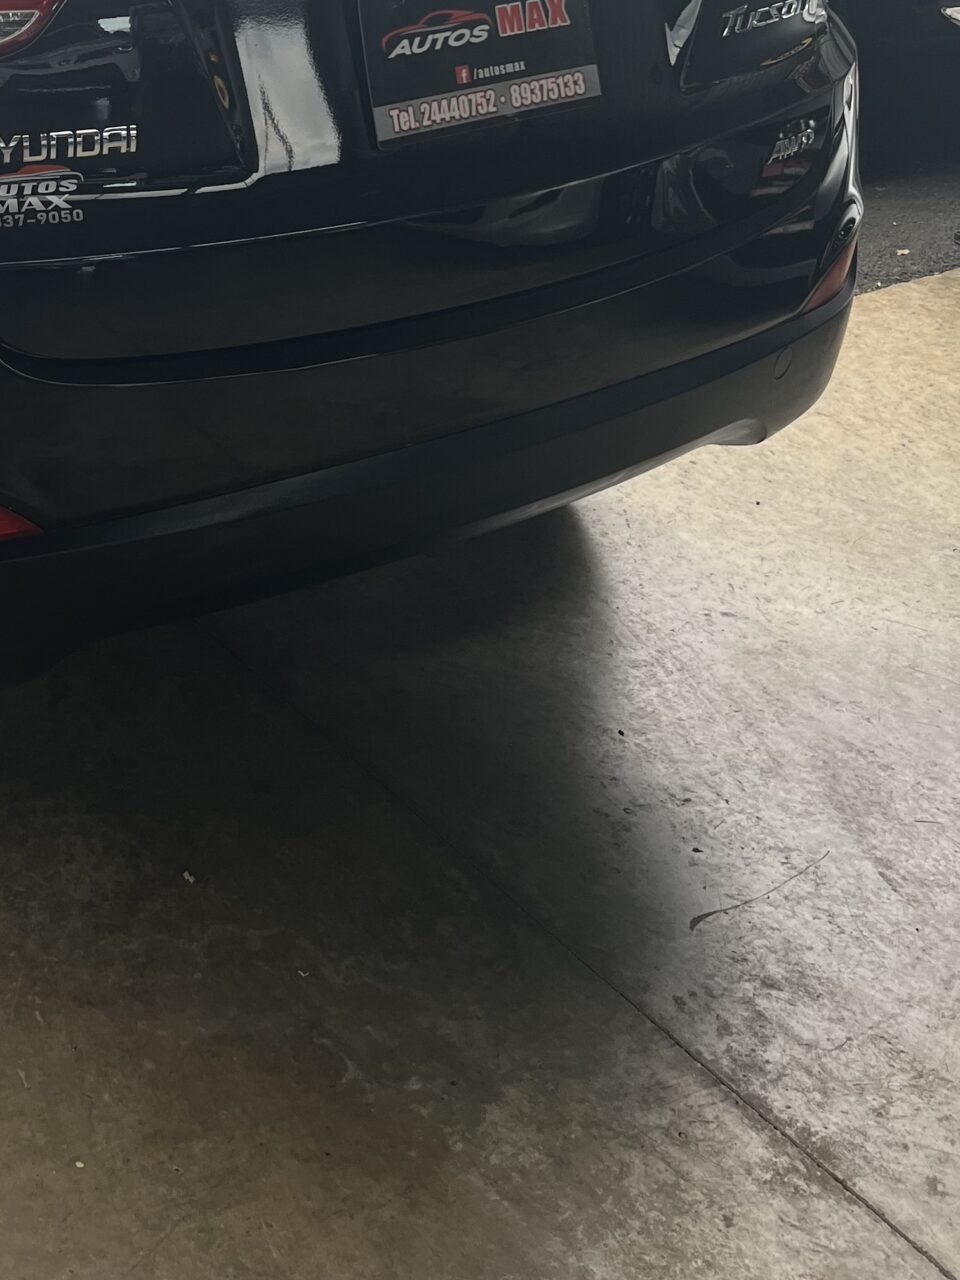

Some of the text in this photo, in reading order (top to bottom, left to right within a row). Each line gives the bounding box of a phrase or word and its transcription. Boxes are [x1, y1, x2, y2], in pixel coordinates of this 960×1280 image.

[387, 24, 492, 59] AUTOS
[473, 60, 526, 80] /autosmax
[390, 71, 586, 134] Tel. 24440752 89375133
